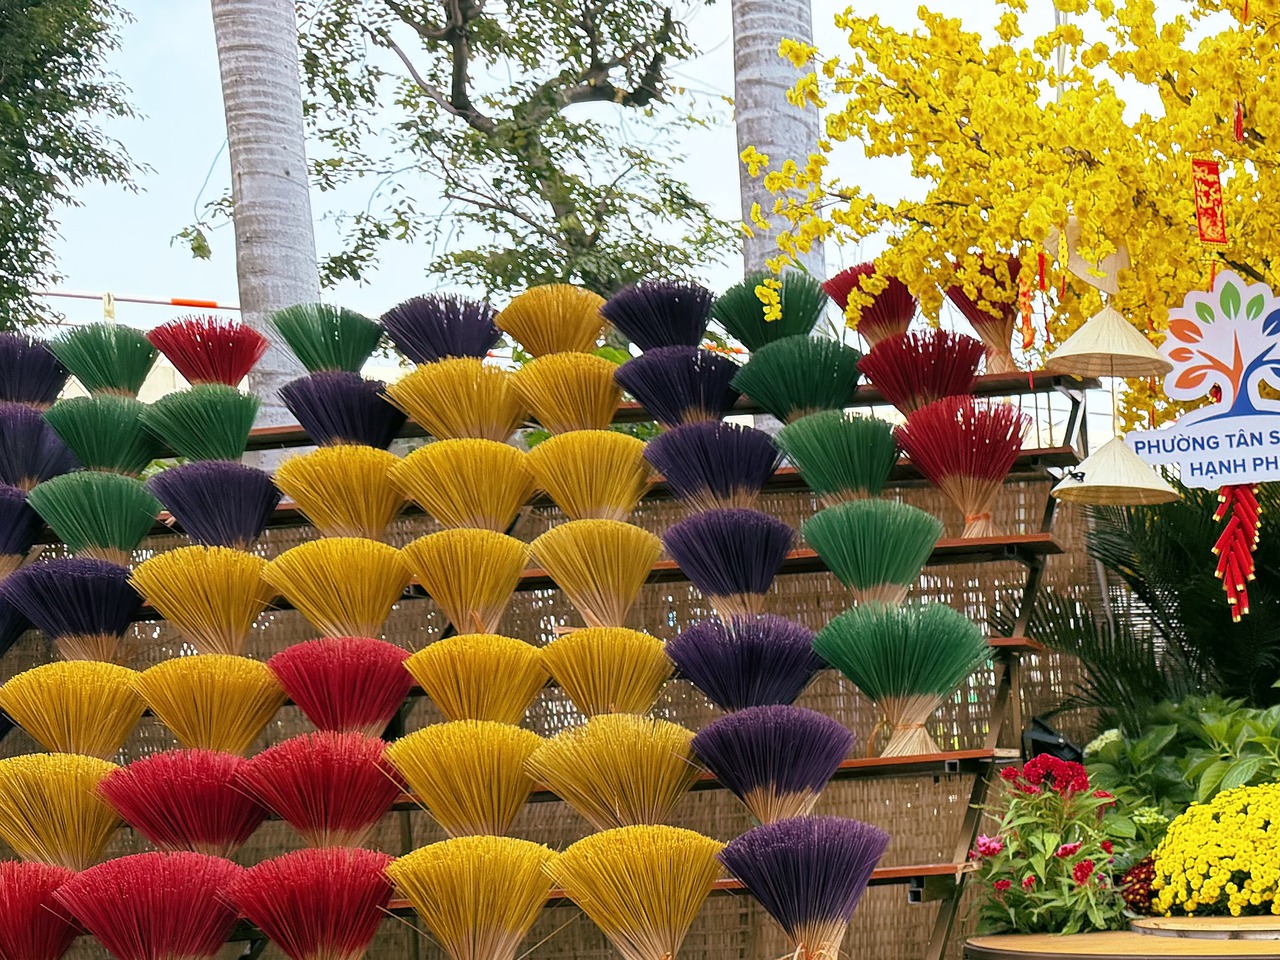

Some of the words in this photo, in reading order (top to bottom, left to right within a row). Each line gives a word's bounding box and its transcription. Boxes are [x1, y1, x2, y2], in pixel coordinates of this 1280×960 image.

[1134, 434, 1220, 455] PHƯỜNG
[1225, 428, 1264, 449] TÂN
[1190, 458, 1246, 479] HẠNH
